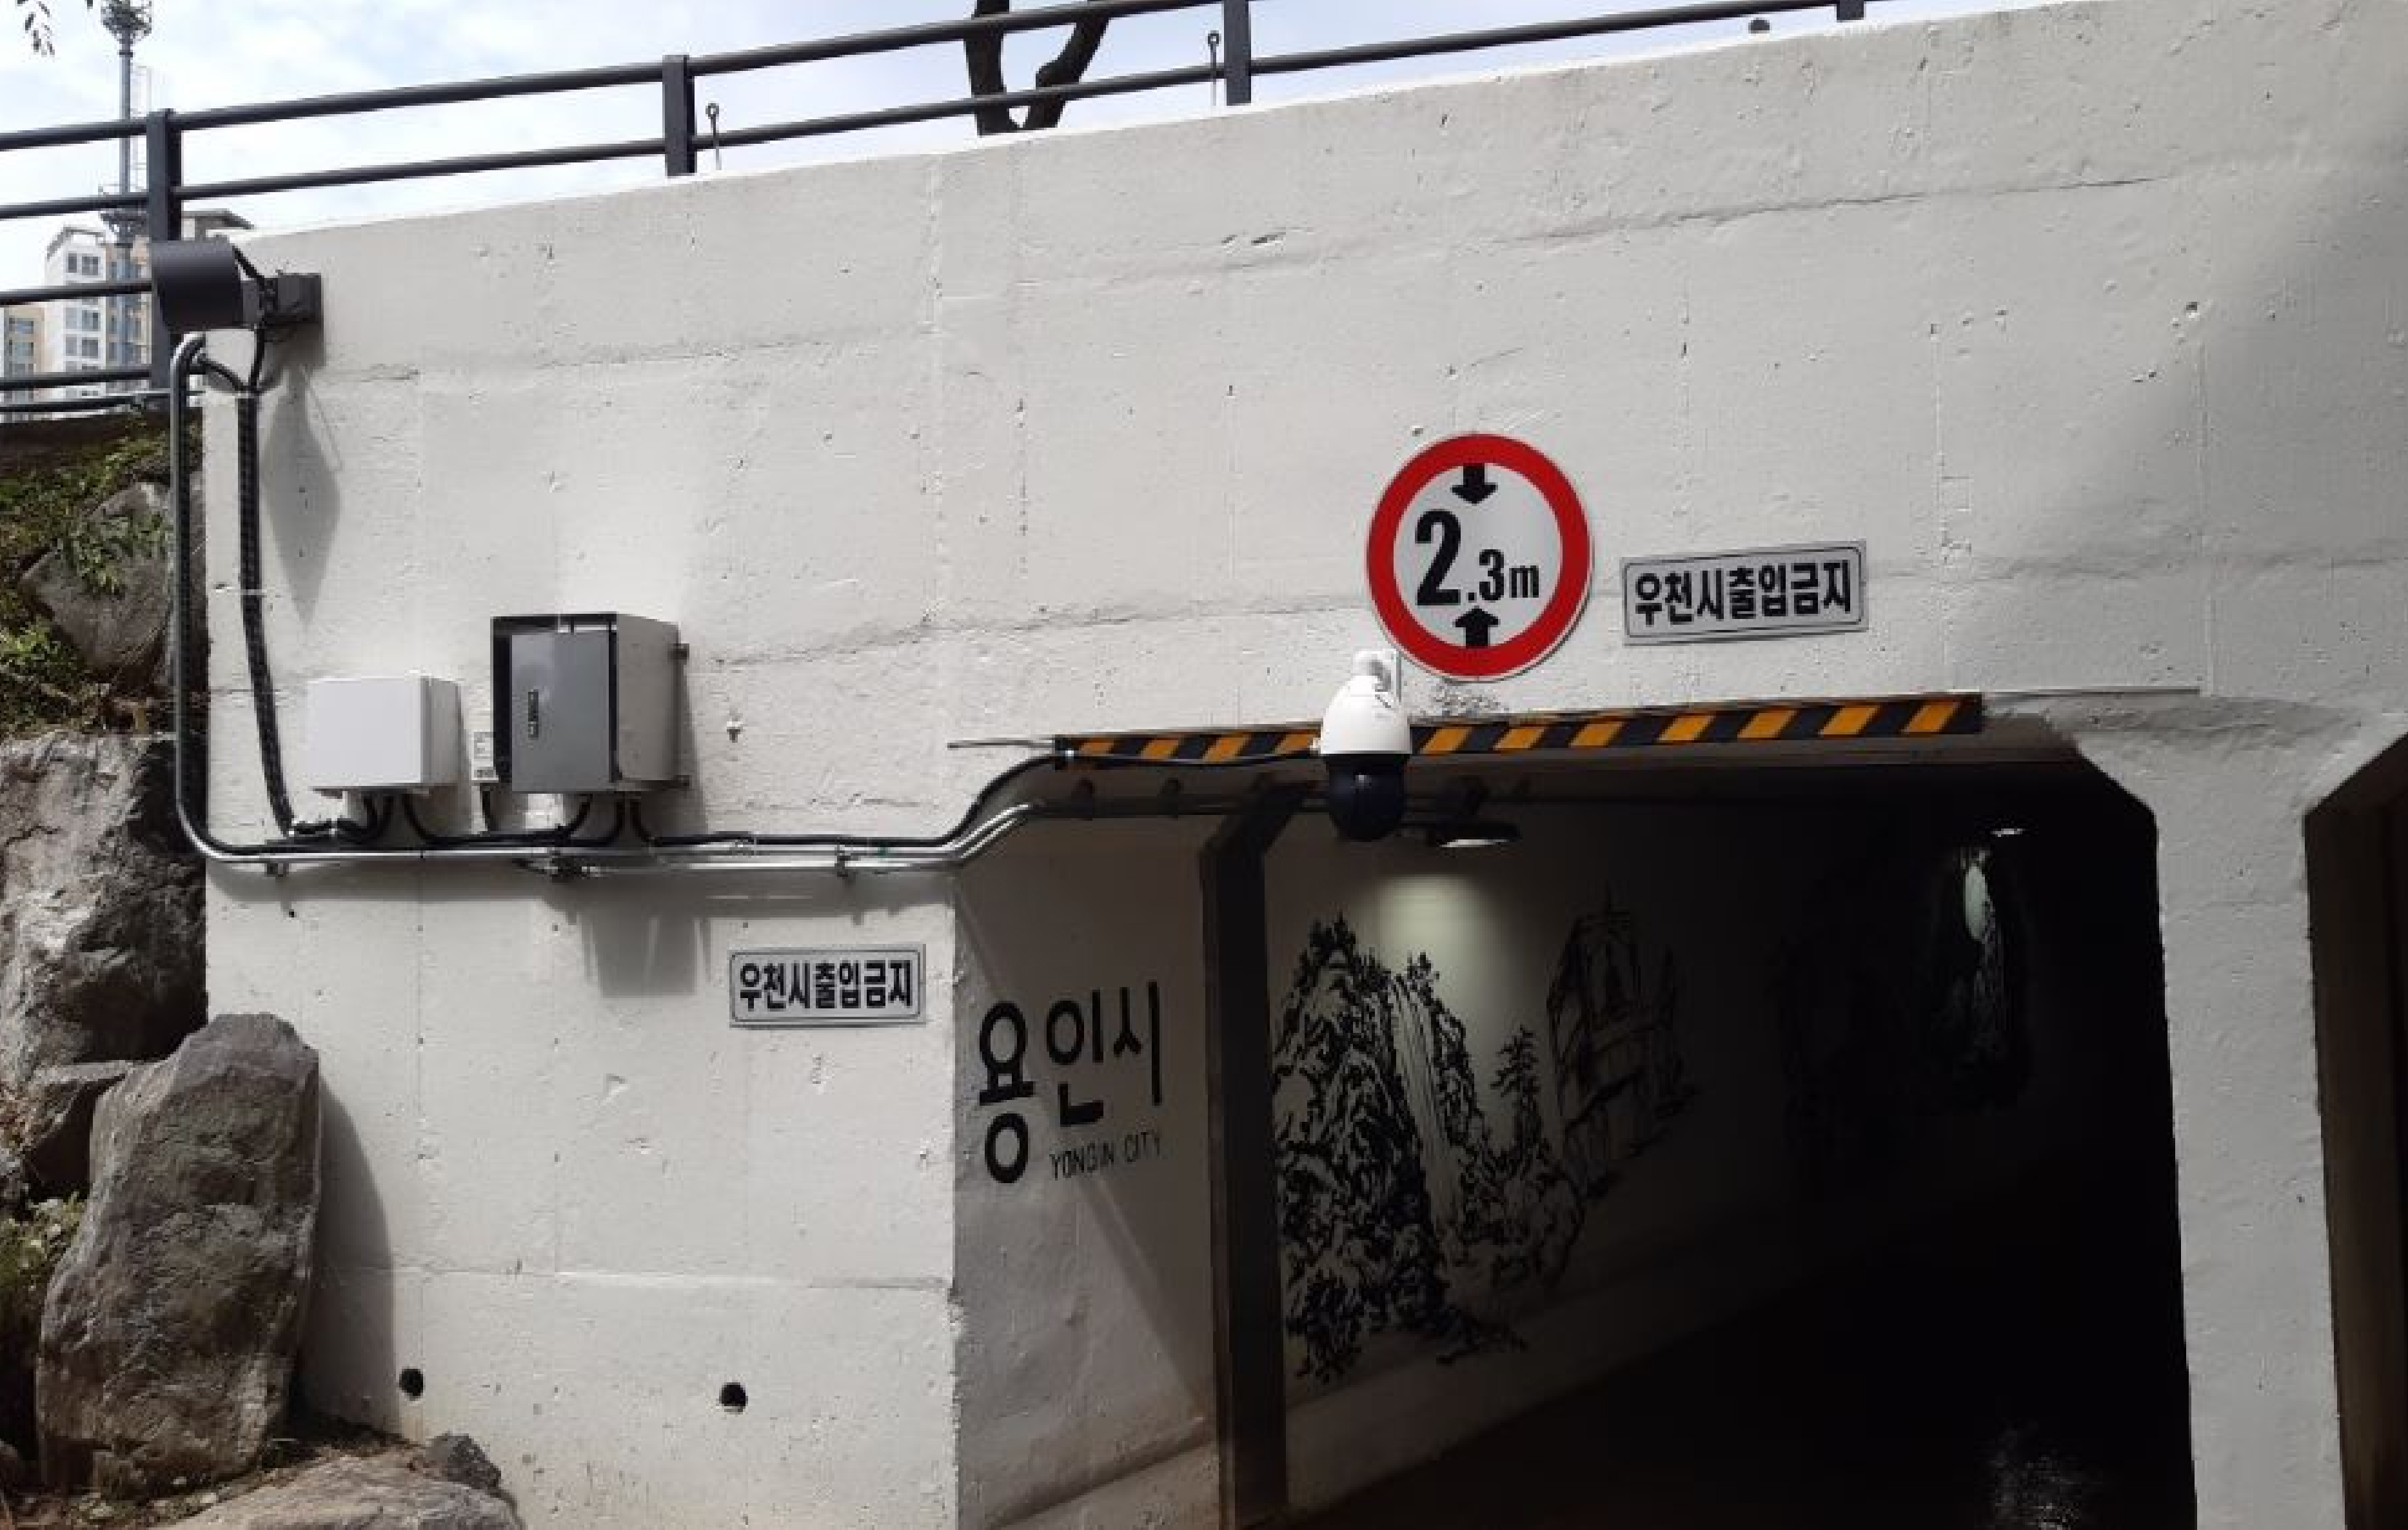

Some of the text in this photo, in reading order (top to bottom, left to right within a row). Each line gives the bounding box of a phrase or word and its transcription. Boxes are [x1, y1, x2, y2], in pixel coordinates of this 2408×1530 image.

[1415, 508, 1540, 607] 2.3m
[1635, 560, 1851, 625] 우천시출입금지
[740, 961, 911, 1010] 우천시출입금지
[979, 980, 1161, 1184] 용인시
[1123, 1130, 1162, 1163] CITY
